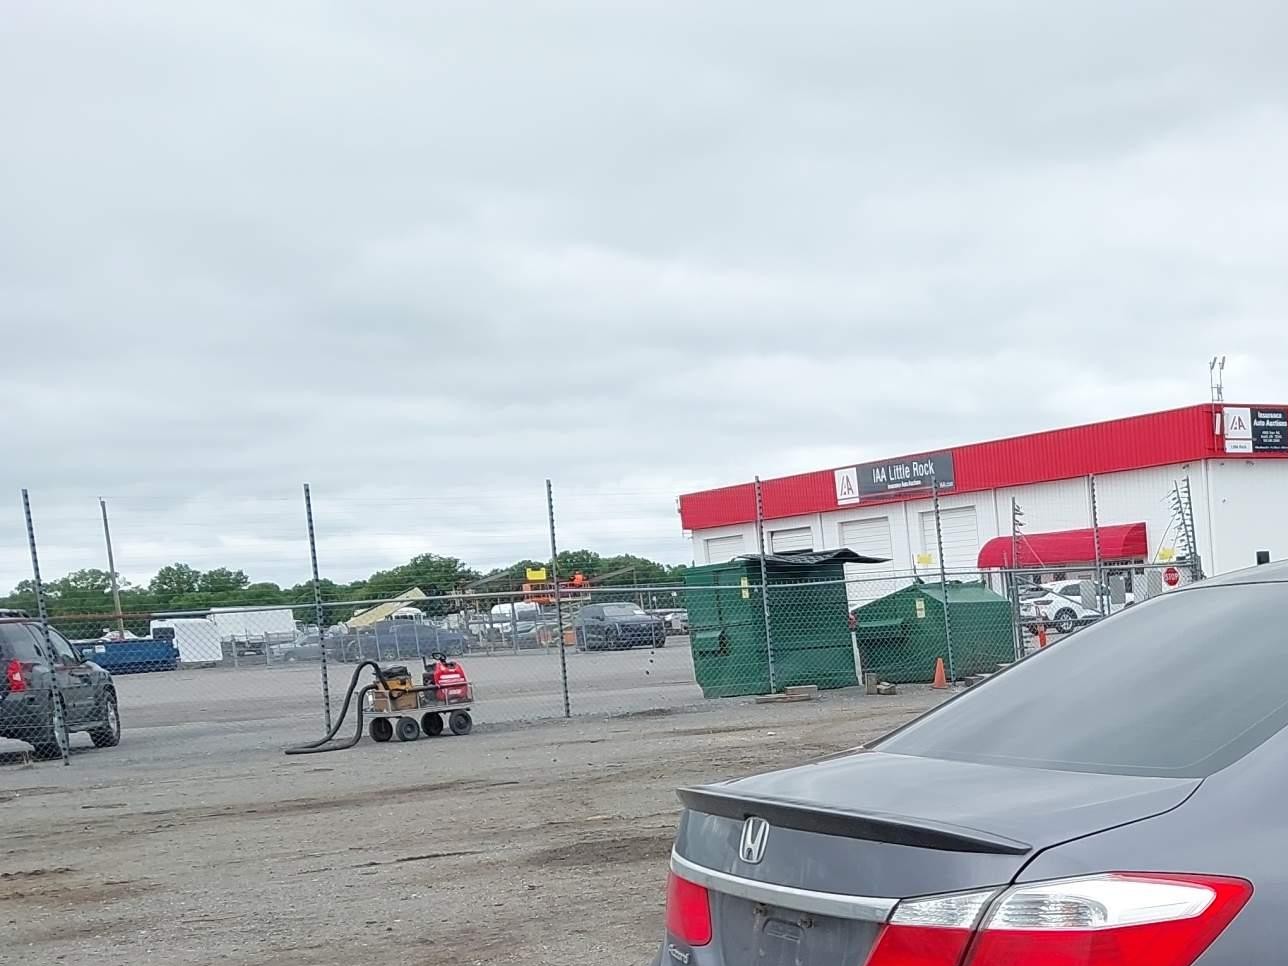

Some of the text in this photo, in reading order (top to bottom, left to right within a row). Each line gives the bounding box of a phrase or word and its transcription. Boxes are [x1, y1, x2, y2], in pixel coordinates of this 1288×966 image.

[872, 460, 935, 484] IAA Little Rock
[1163, 572, 1179, 583] STOP
